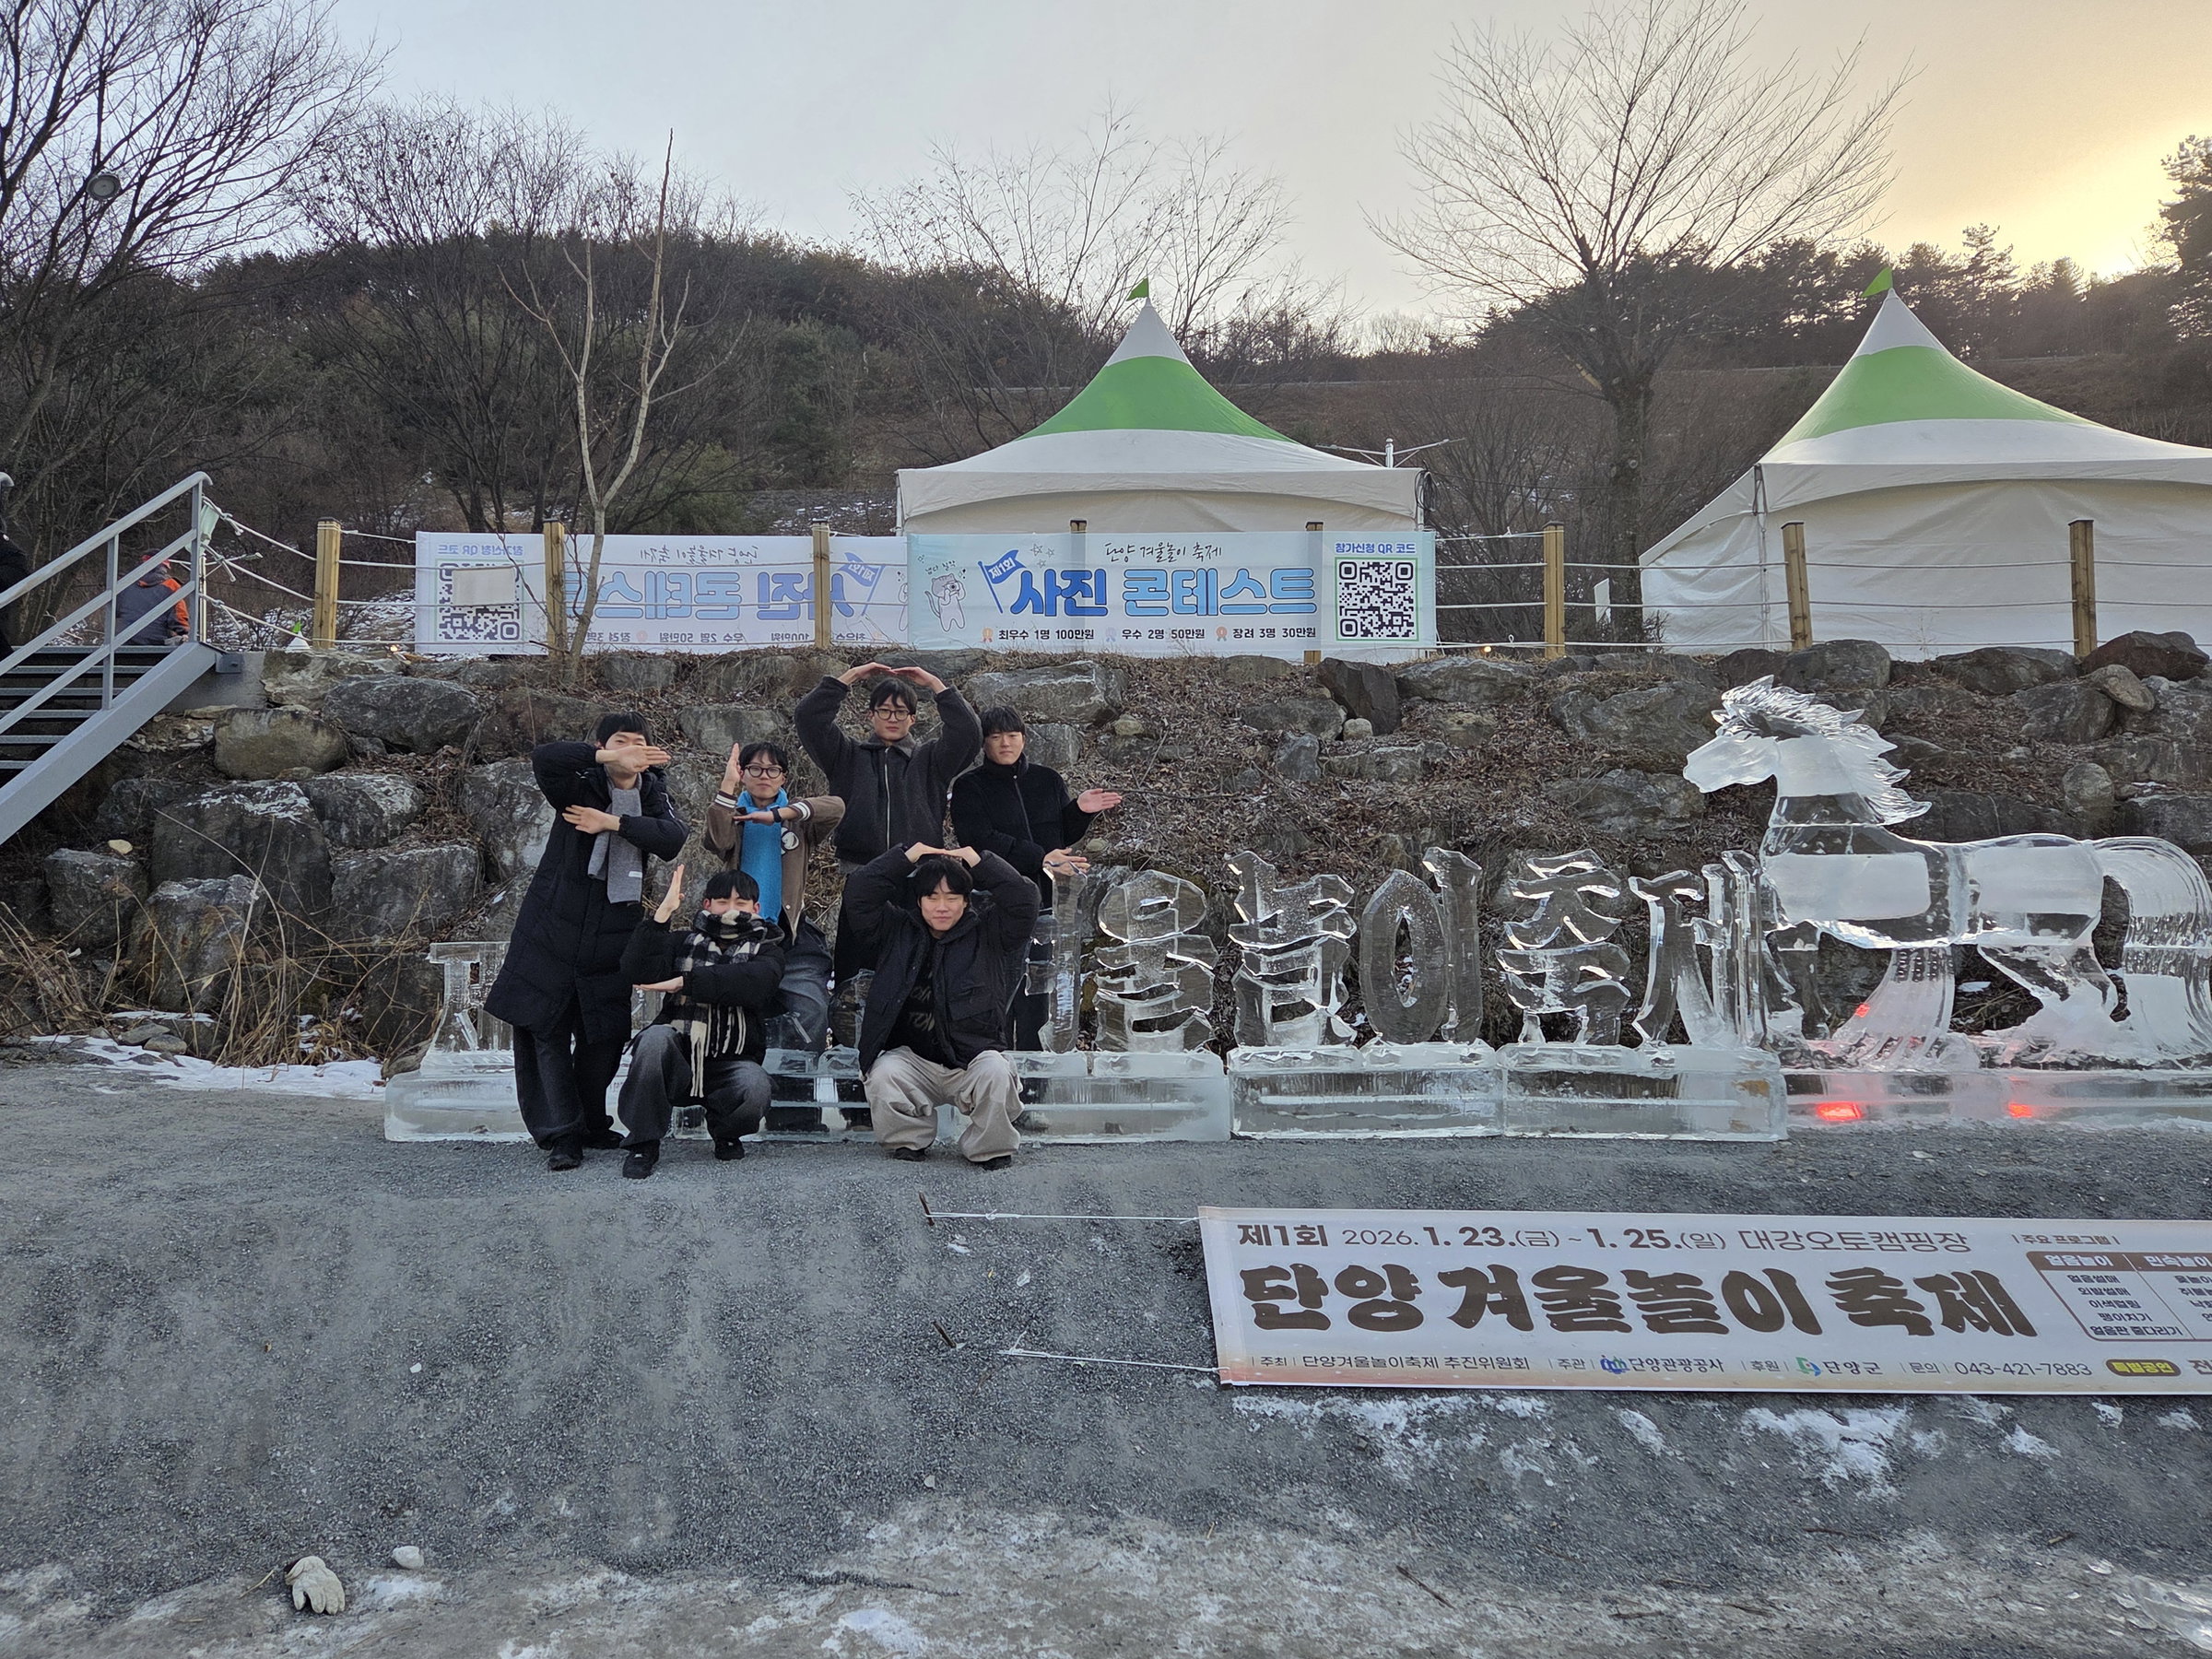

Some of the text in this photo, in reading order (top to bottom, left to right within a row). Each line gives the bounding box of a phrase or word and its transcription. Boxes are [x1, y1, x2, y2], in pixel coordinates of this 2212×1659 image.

[1105, 541, 1222, 563] 단양 겨울놀이 축제
[1335, 542, 1417, 555] 참가신청 QR 코드
[988, 557, 1017, 580] 제1회
[1010, 569, 1318, 617] 사진 콘테스트
[998, 629, 1095, 640] 최우수 1명 100만원
[1122, 629, 1206, 640] 우수 2명 50만원
[1232, 628, 1317, 640] 장려 3명 30만원
[1237, 1224, 1329, 1247] 제1회
[1737, 1230, 1973, 1253] 대강오토캠핑장
[2021, 1234, 2112, 1244] 주요 프로그램
[2044, 1254, 2114, 1266] 얼음놀이
[1240, 1264, 1424, 1333] 단양
[1260, 1356, 1288, 1368] 주최
[1302, 1355, 1531, 1371] 단양겨울놀이축제 추진위원회
[1558, 1358, 1589, 1371] 주관
[1629, 1357, 1724, 1373] 단양관광공사
[1750, 1359, 1781, 1373] 후원
[1823, 1359, 1883, 1375] 단양군
[1911, 1361, 1942, 1374] 문의
[1954, 1361, 2092, 1376] 043-421-7883
